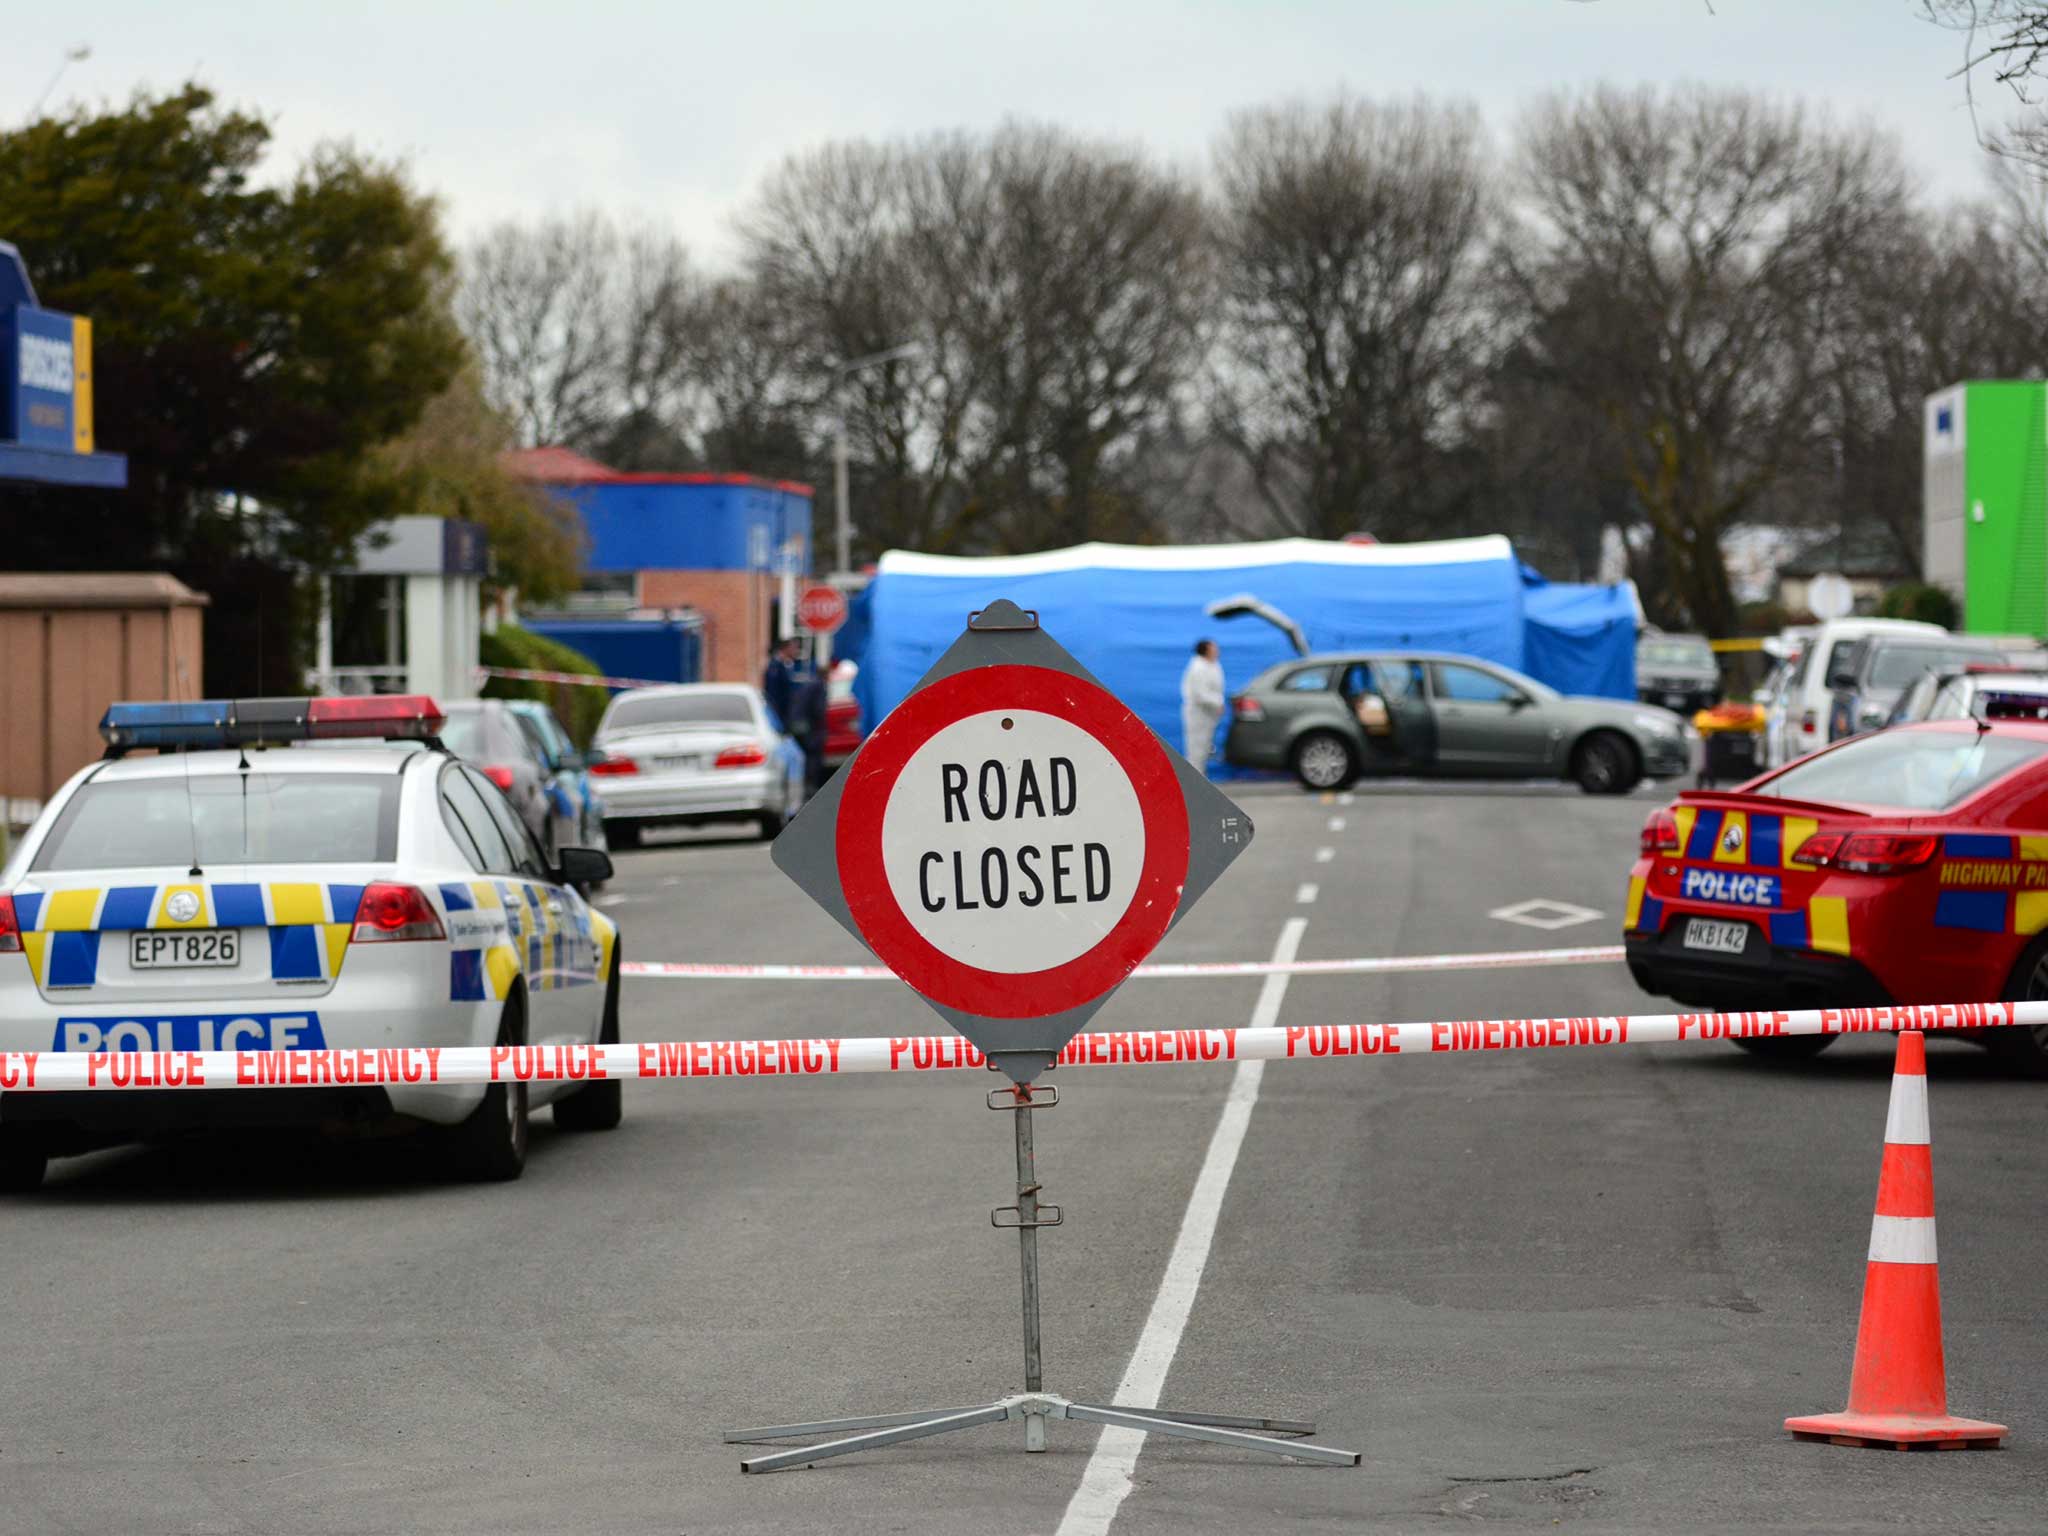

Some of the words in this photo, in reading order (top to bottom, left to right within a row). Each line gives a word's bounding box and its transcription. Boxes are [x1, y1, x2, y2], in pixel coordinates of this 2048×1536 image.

[942, 757, 1077, 822] ROAD
[919, 842, 1111, 912] CLOSED
[1686, 869, 1774, 905] POLICE
[1940, 863, 2022, 886] HIGHWAY
[135, 935, 235, 962] EPT826
[1687, 924, 1745, 949] HKB142
[88, 1050, 205, 1087] POLICE
[236, 1048, 441, 1085] EMERGENCY
[490, 1044, 607, 1081] POLICE
[638, 1039, 841, 1078] EMERGENCY
[1058, 1028, 1237, 1065] MERGENCY
[1286, 1023, 1400, 1057] POLICE
[1431, 1016, 1629, 1052] EMERGENCY
[1677, 1011, 1789, 1041] POLICE
[1820, 1001, 2015, 1034] EMERGENCY
